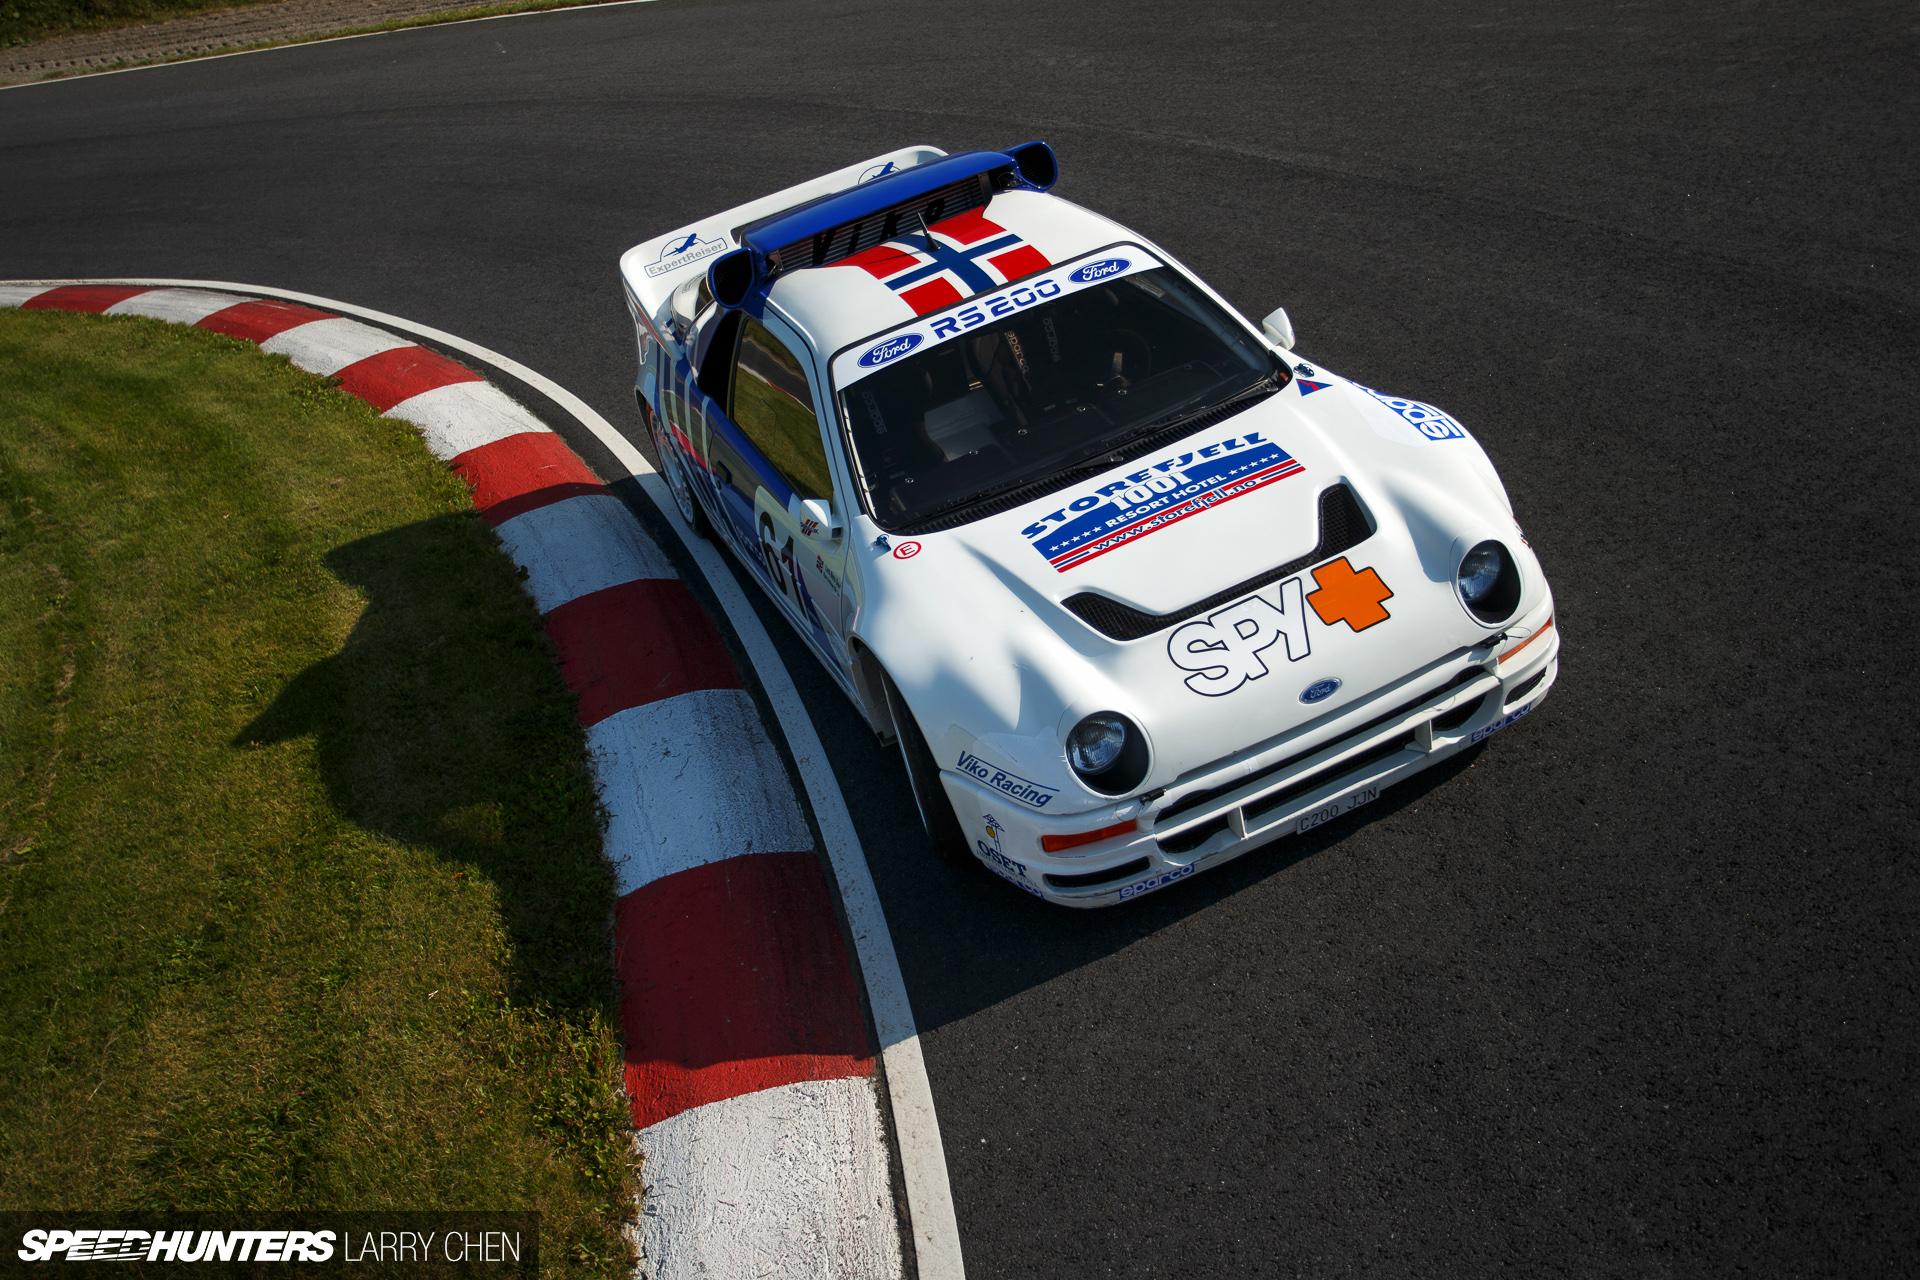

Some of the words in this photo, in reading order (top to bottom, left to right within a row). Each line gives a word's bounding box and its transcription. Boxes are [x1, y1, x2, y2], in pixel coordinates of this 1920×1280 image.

[649, 243, 723, 275] ExpertReiser
[1081, 260, 1121, 282] Ford
[871, 338, 912, 364] Ford
[1020, 431, 1268, 540] STOREFJELL
[1105, 496, 1171, 528] RESORT
[1174, 473, 1228, 501] HOTEL
[1110, 470, 1193, 512] 1001
[1092, 478, 1258, 552] www.storefjell.no
[1166, 576, 1312, 698] SPY
[956, 750, 989, 780] Viko
[989, 771, 1054, 808] Racing
[1300, 804, 1340, 832] C200
[1347, 786, 1378, 810] JJN
[977, 839, 1028, 878] OSET
[1120, 864, 1194, 898] sparco
